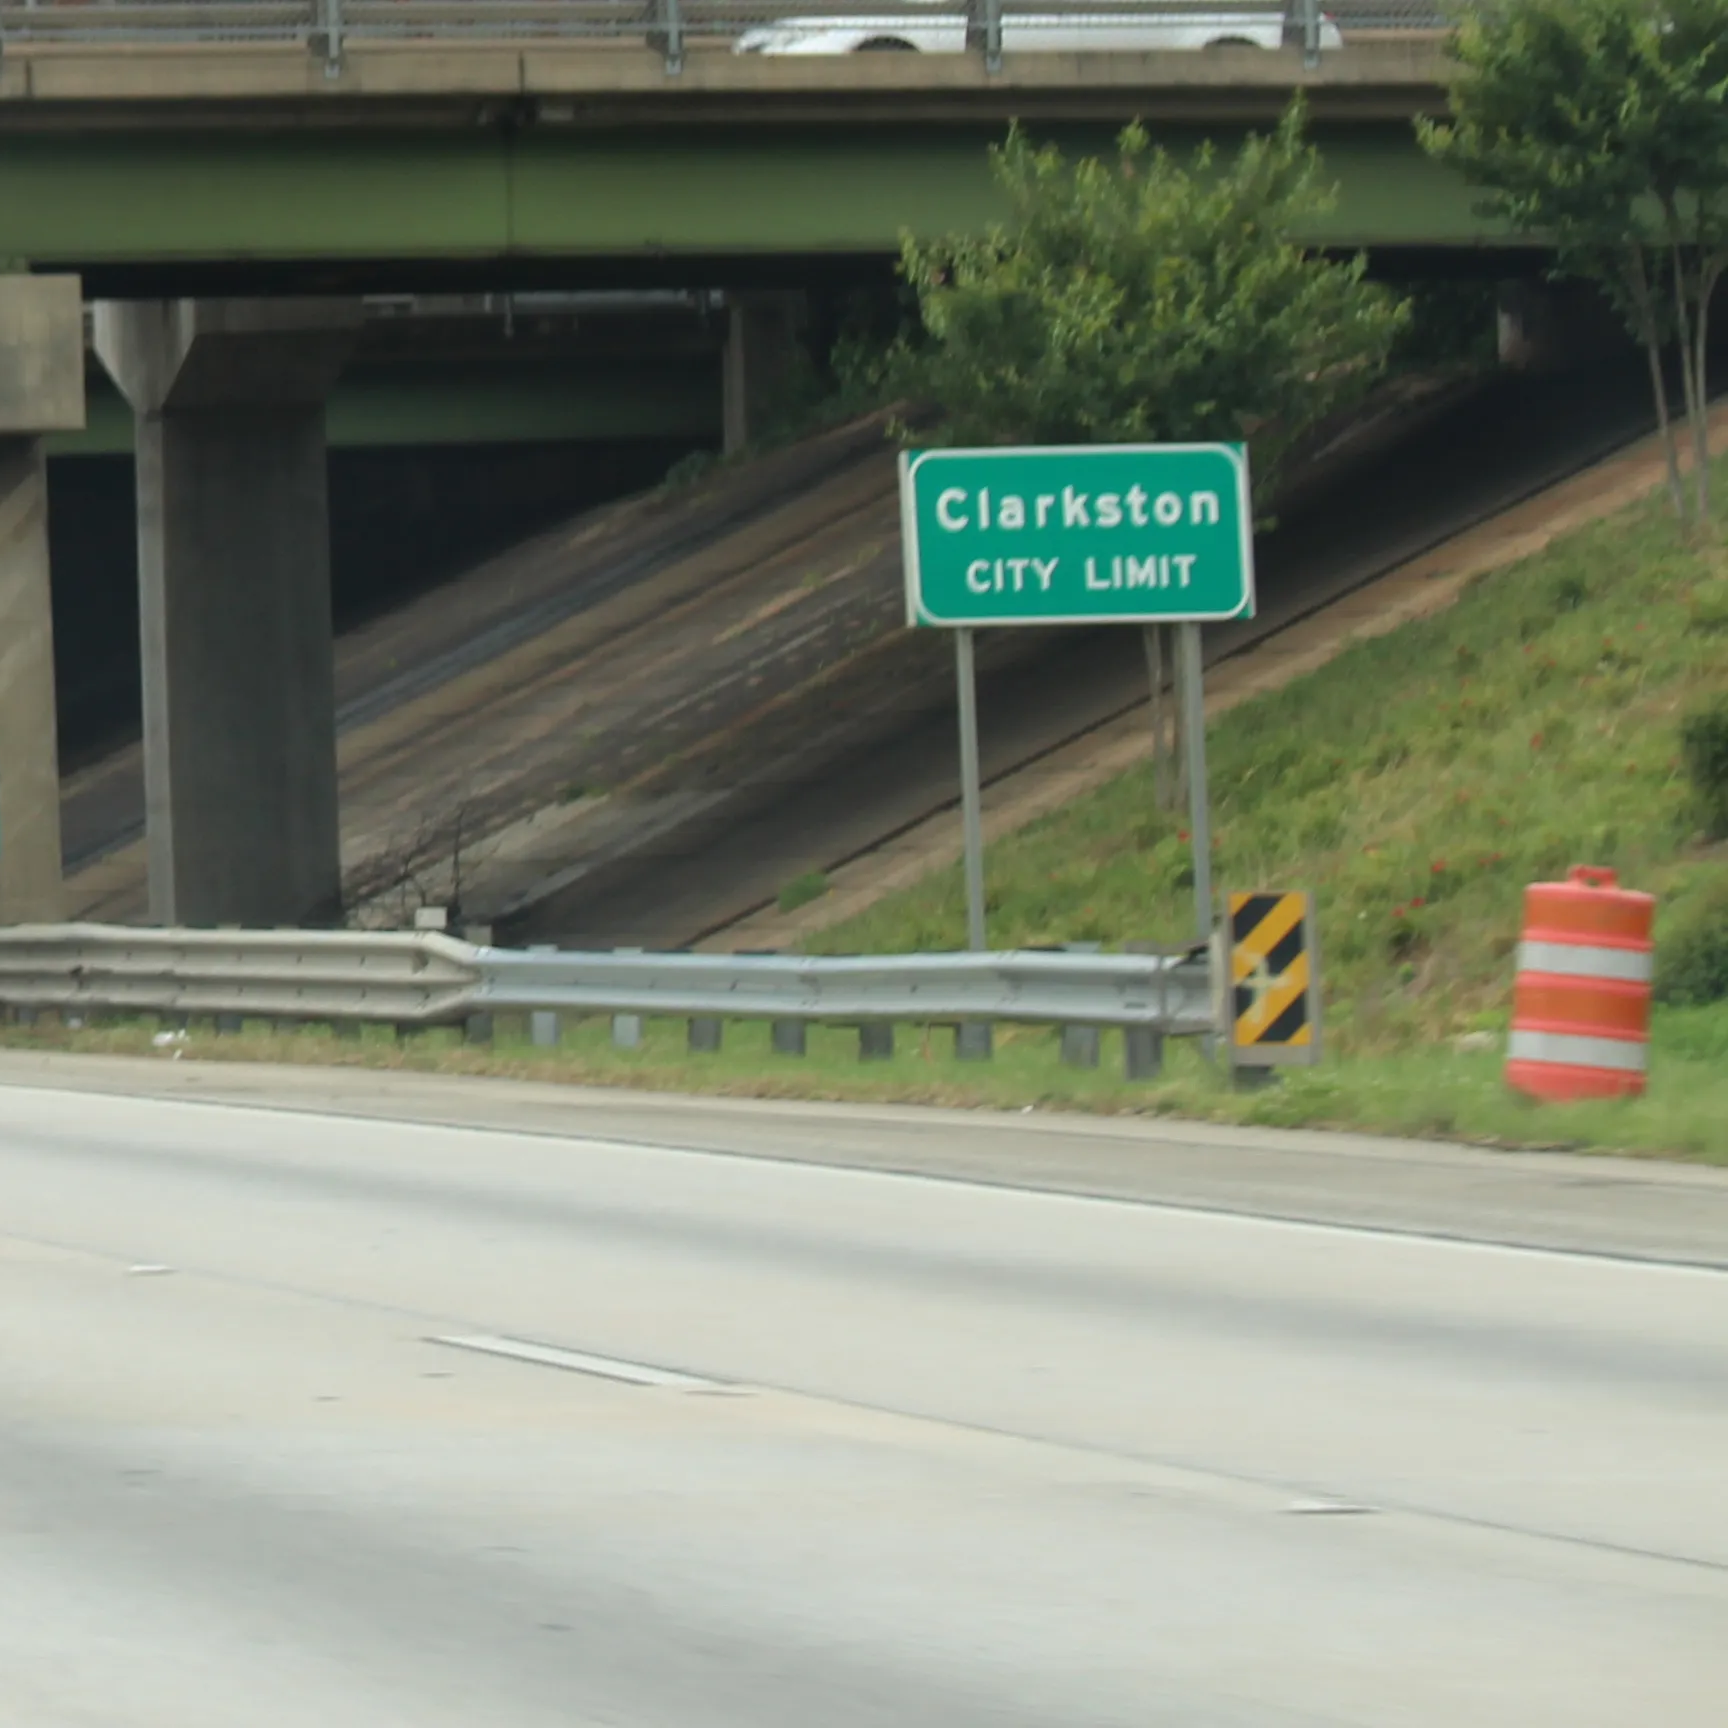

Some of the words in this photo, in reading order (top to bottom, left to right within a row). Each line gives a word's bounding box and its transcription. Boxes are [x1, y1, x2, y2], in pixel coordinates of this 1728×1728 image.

[935, 484, 1220, 531] Clarkston
[965, 556, 1059, 593] CITY
[1084, 554, 1197, 591] LIMIT
